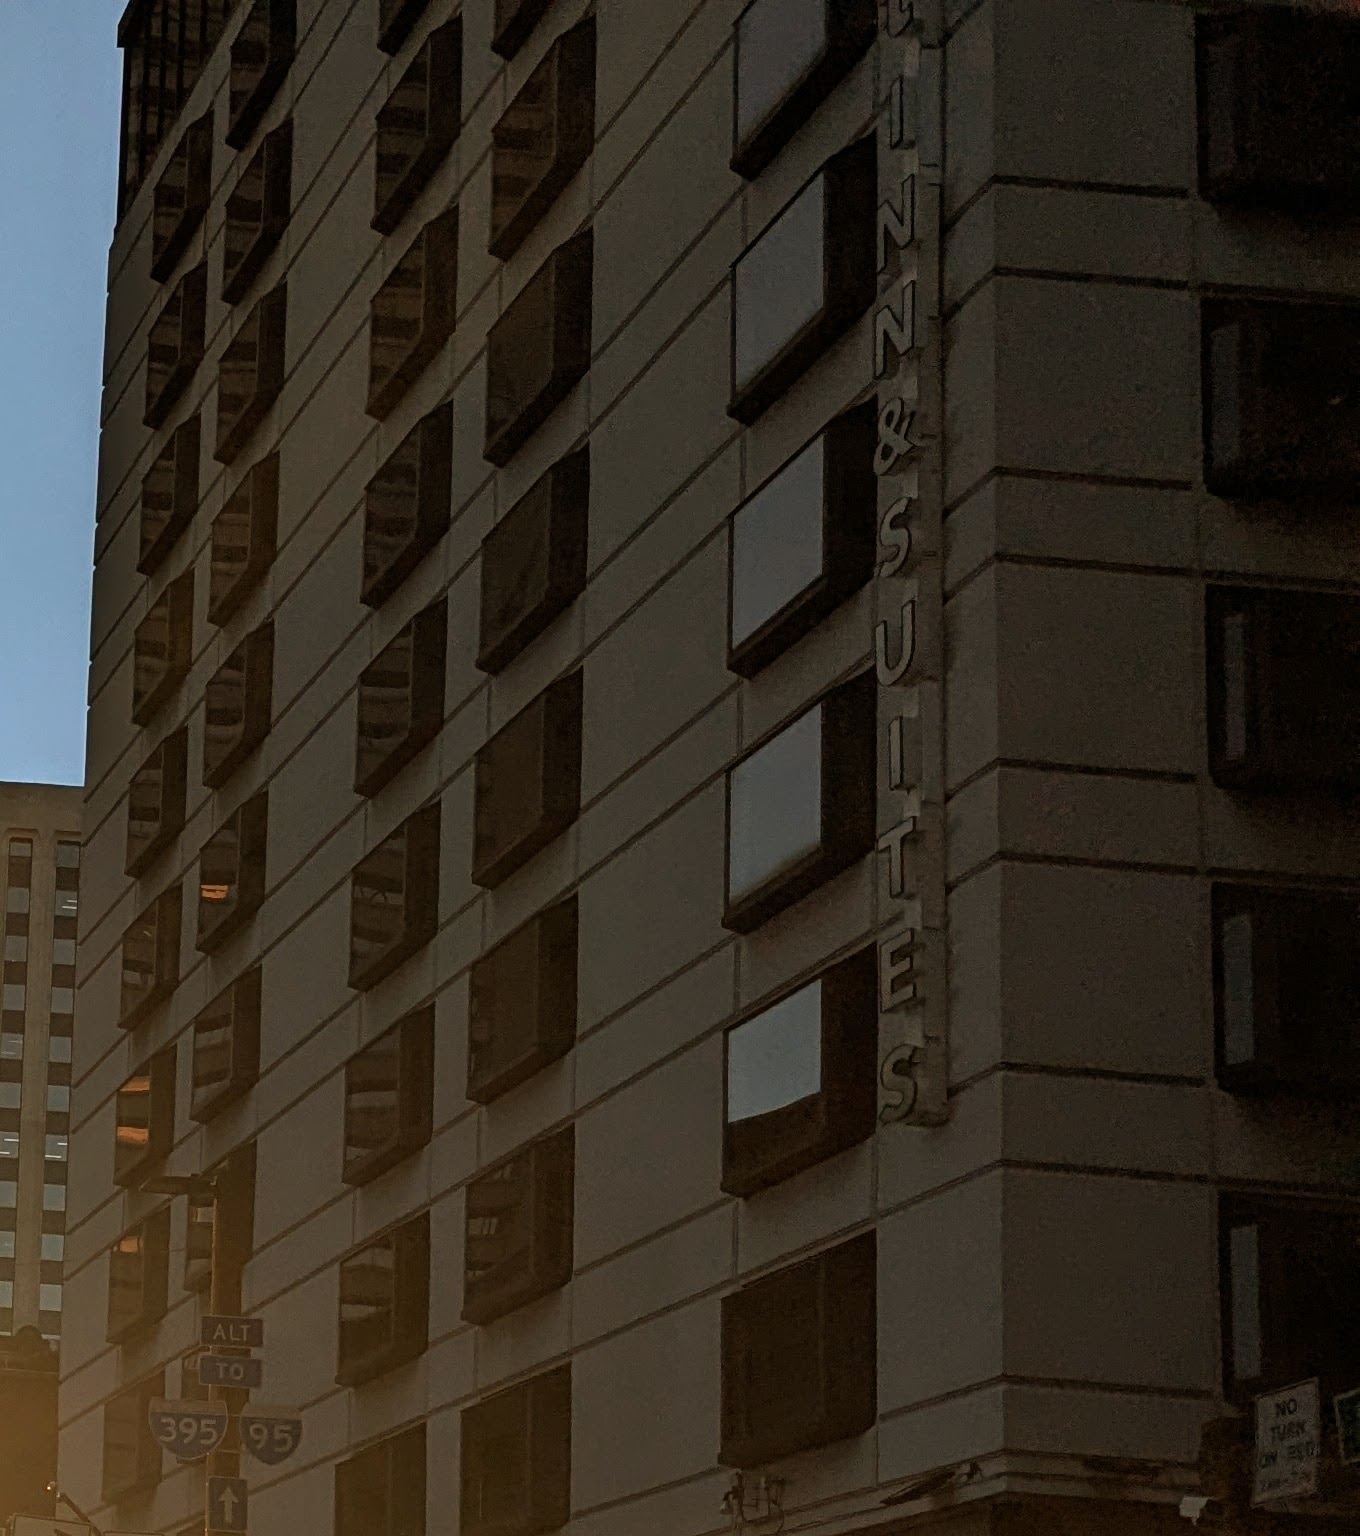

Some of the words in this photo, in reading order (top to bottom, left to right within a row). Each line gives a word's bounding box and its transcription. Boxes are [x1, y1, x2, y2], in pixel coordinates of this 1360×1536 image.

[873, 496, 925, 1130] SUITES
[212, 1322, 251, 1342] ALT
[215, 1362, 244, 1381] TO
[158, 1416, 218, 1446] 395
[248, 1422, 293, 1453] 95
